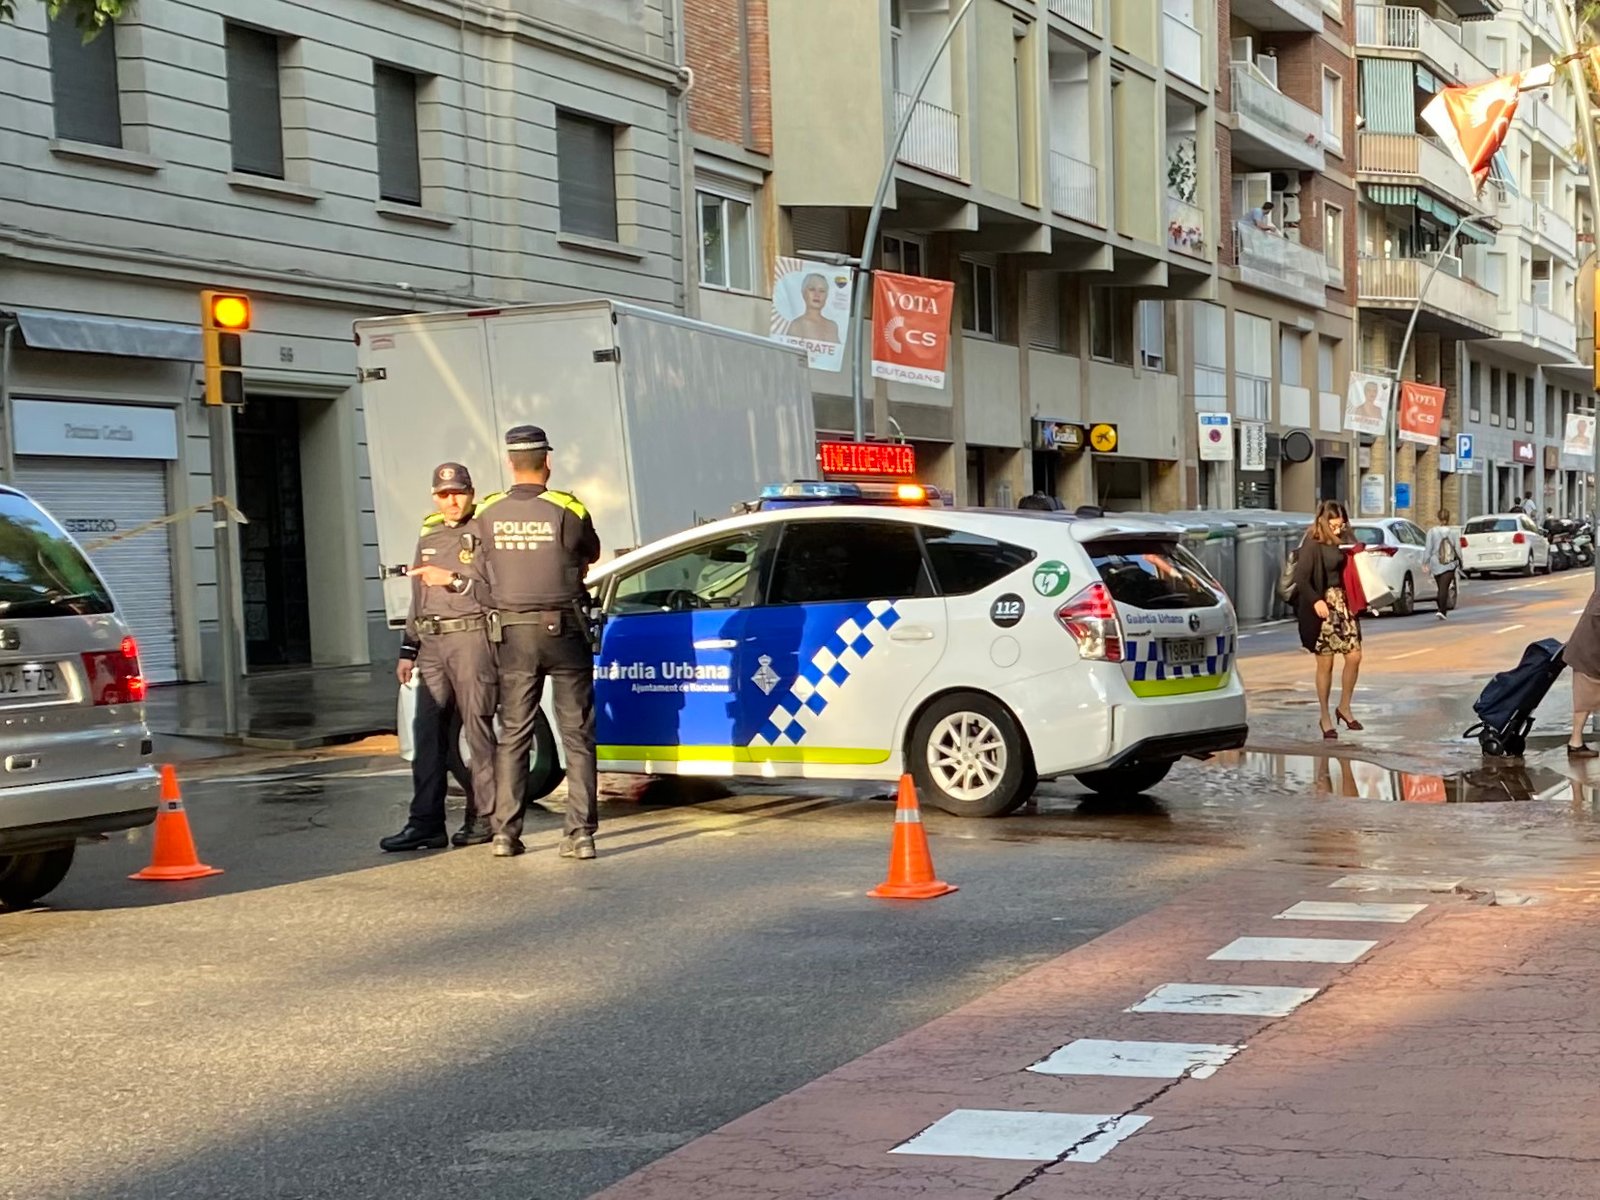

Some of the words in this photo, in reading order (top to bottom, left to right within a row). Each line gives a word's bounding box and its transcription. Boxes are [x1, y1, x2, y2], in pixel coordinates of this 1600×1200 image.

[886, 291, 939, 315] VOTA
[904, 330, 937, 347] CS
[1407, 391, 1437, 407] VOTA
[1460, 437, 1471, 457] P
[822, 444, 913, 473] INCIDENCIA
[64, 518, 117, 532] SEIKO
[493, 521, 553, 534] POLICIA
[995, 601, 1021, 614] 112
[1158, 614, 1184, 624] Urbana
[661, 661, 730, 680] Urbana
[22, 668, 57, 691] FZR
[631, 684, 678, 693] Ajuntament
[690, 683, 730, 692] Barcelona
